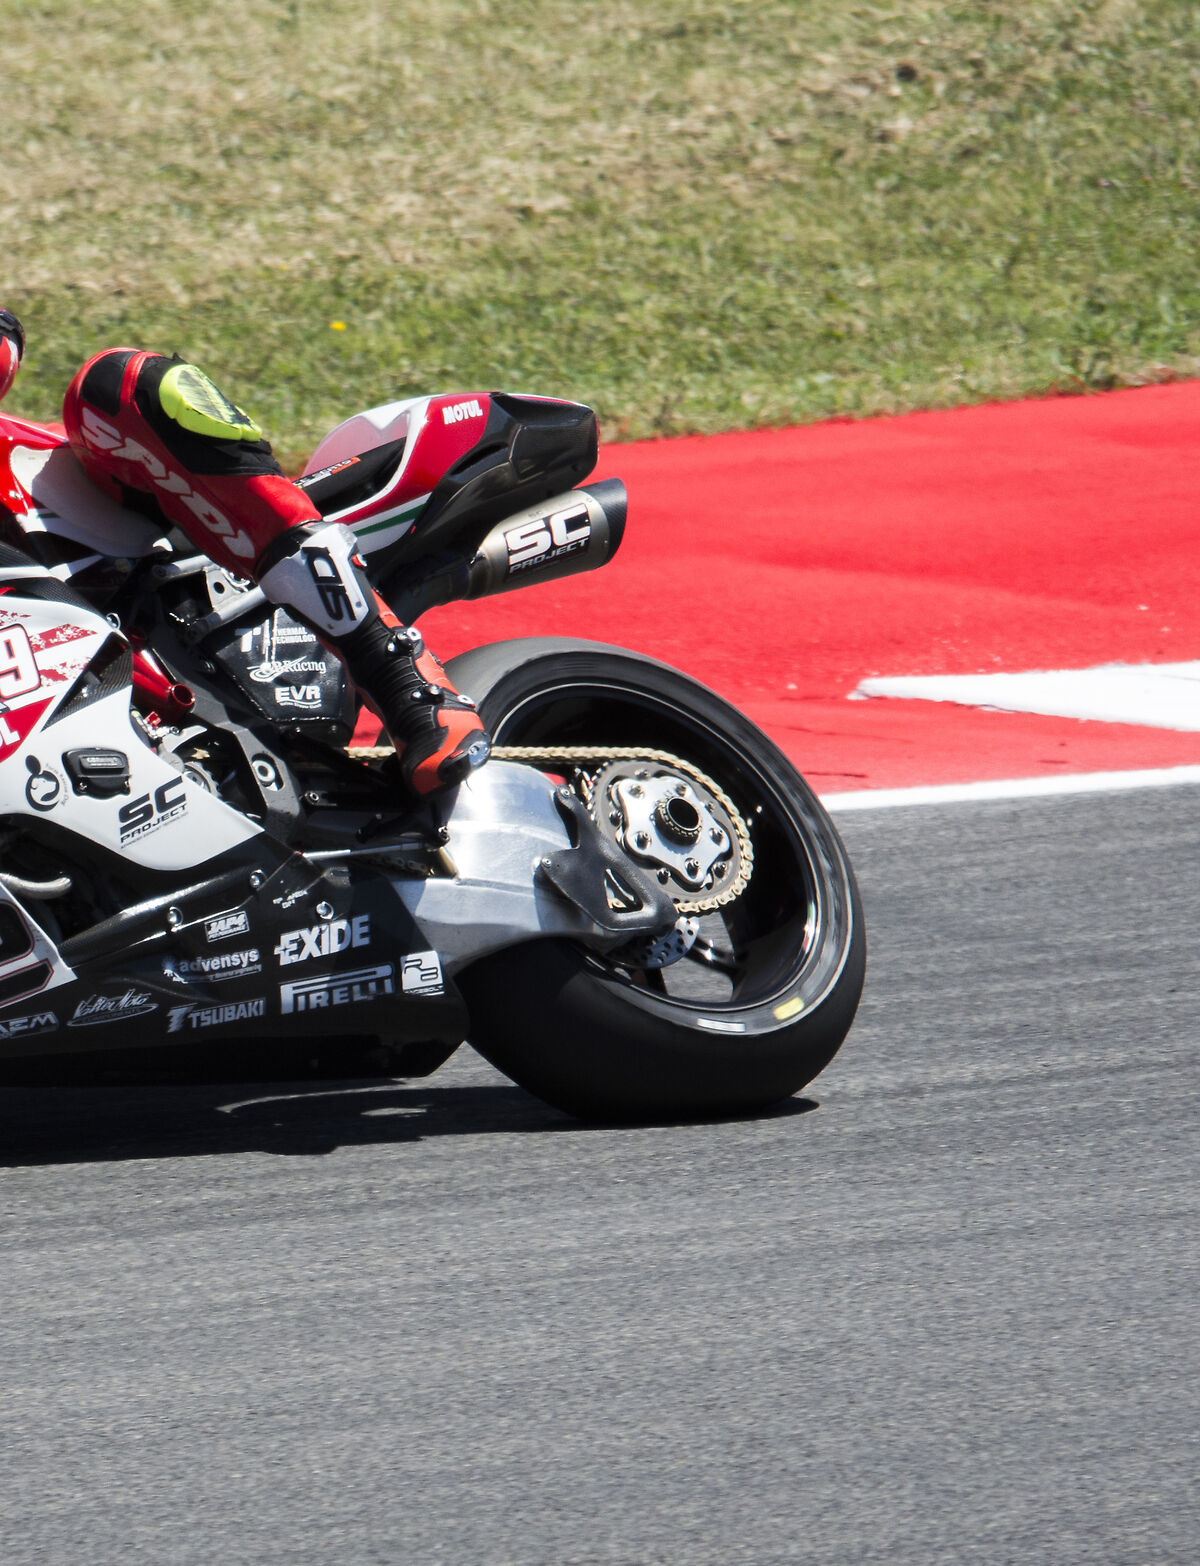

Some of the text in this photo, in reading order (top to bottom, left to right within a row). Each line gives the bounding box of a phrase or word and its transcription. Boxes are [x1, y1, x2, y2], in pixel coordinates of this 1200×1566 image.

[442, 399, 484, 425] MOTUL
[81, 406, 256, 559] SPIDI
[505, 503, 591, 567] SC
[509, 537, 590, 574] PROJECT
[275, 685, 321, 701] EVR
[118, 775, 187, 836] SC
[120, 803, 188, 844] PROJECT
[179, 948, 260, 972] advensys
[274, 914, 371, 966] EXIDE
[280, 964, 393, 1014] PIRELLI
[187, 999, 265, 1029] TSUBAKI
